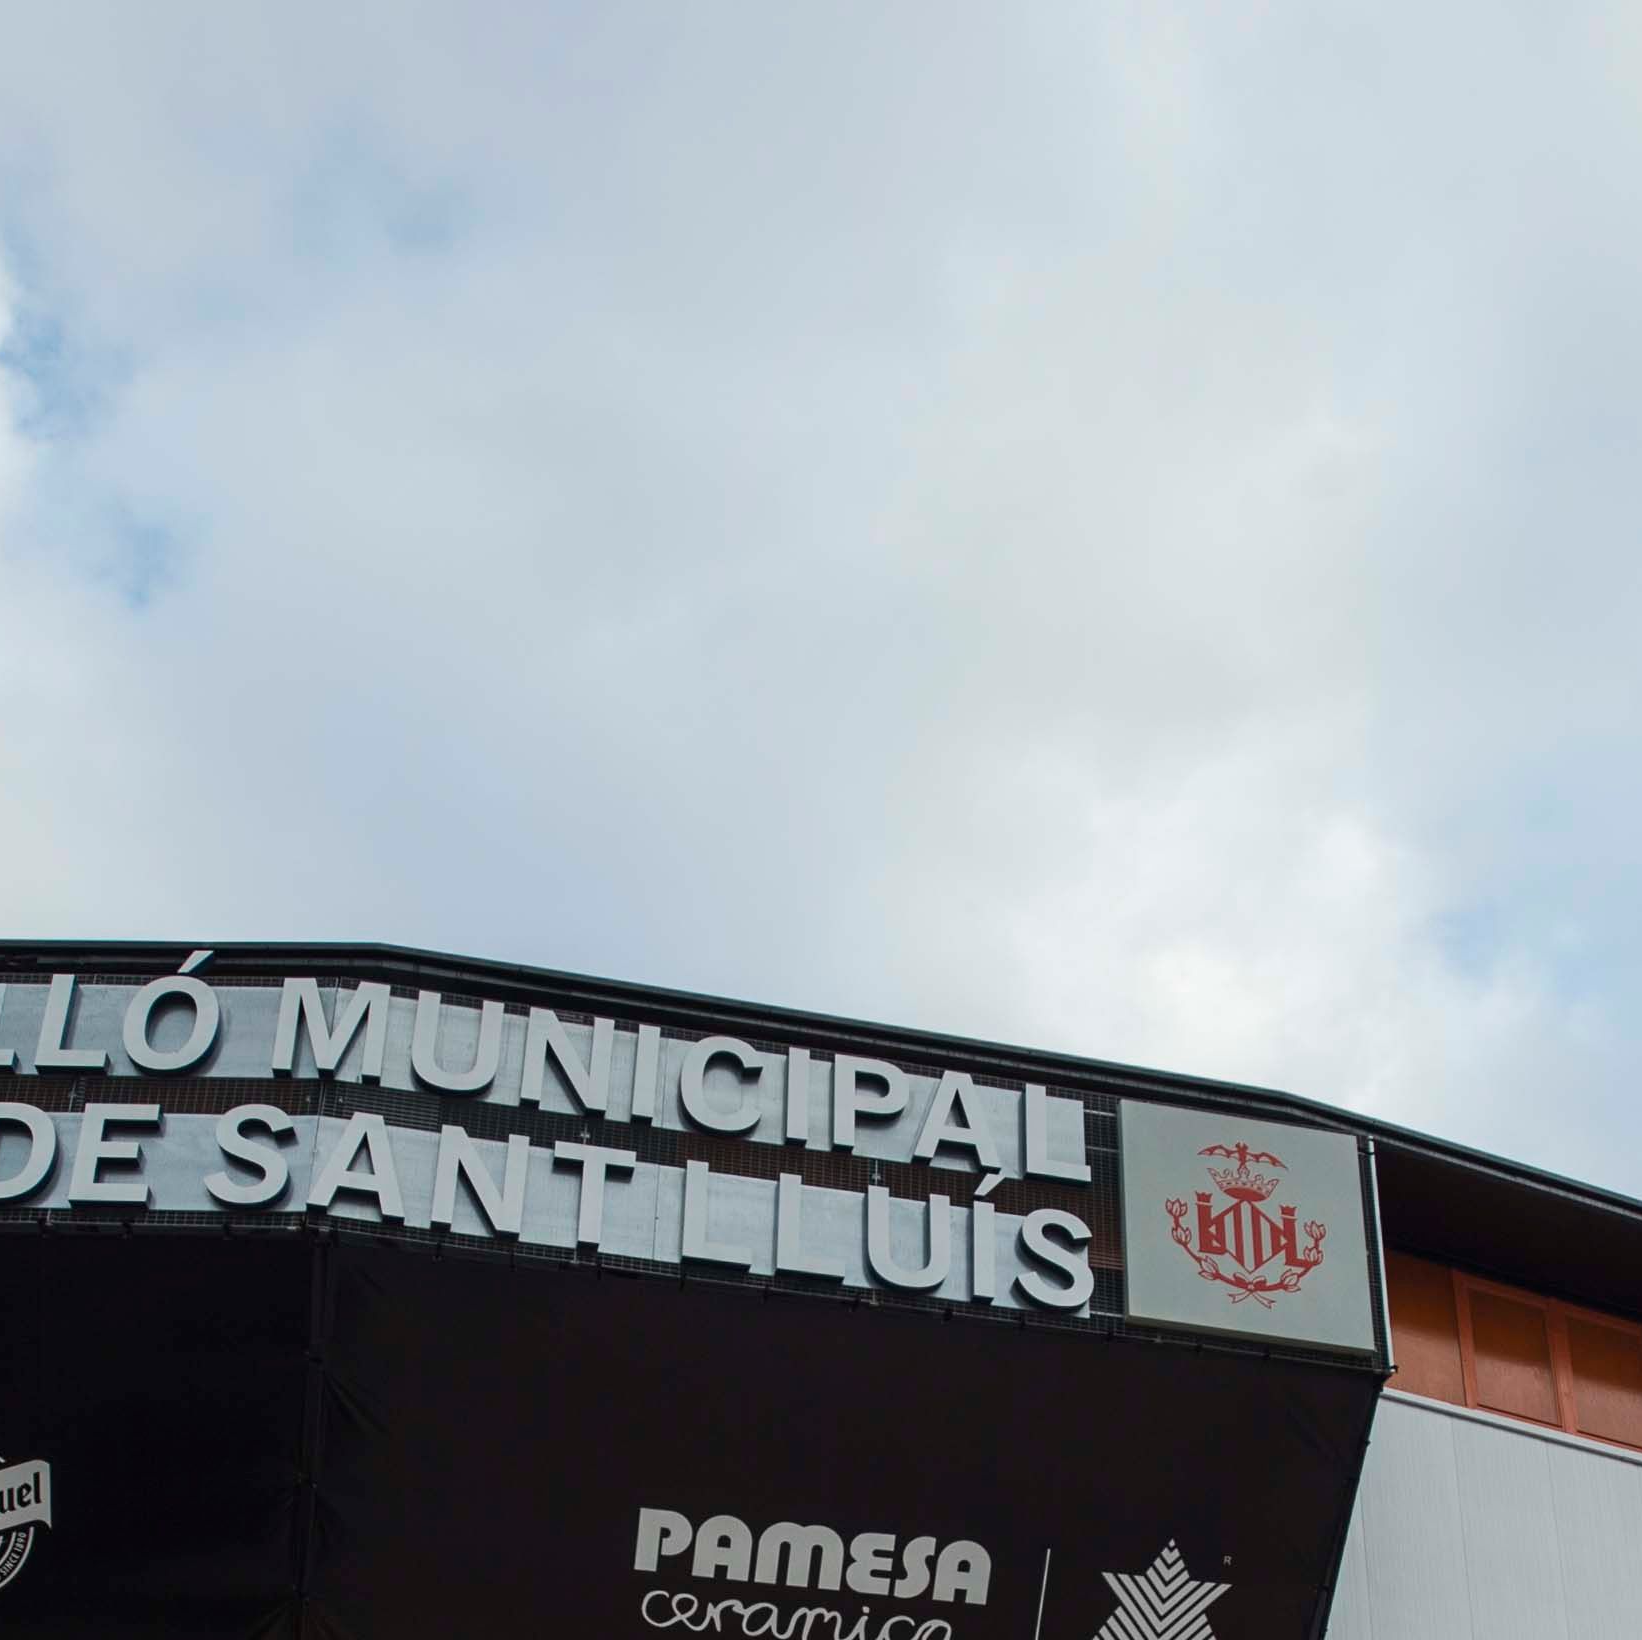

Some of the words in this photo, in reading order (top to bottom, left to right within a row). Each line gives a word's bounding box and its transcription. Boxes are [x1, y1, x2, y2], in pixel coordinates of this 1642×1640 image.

[271, 976, 1091, 1184] MUNICIPAL
[203, 1104, 636, 1252] SANT
[681, 1159, 1095, 1311] LLUÍS
[0, 1554, 20, 1576] SINCE
[634, 1507, 992, 1606] PAMESA
